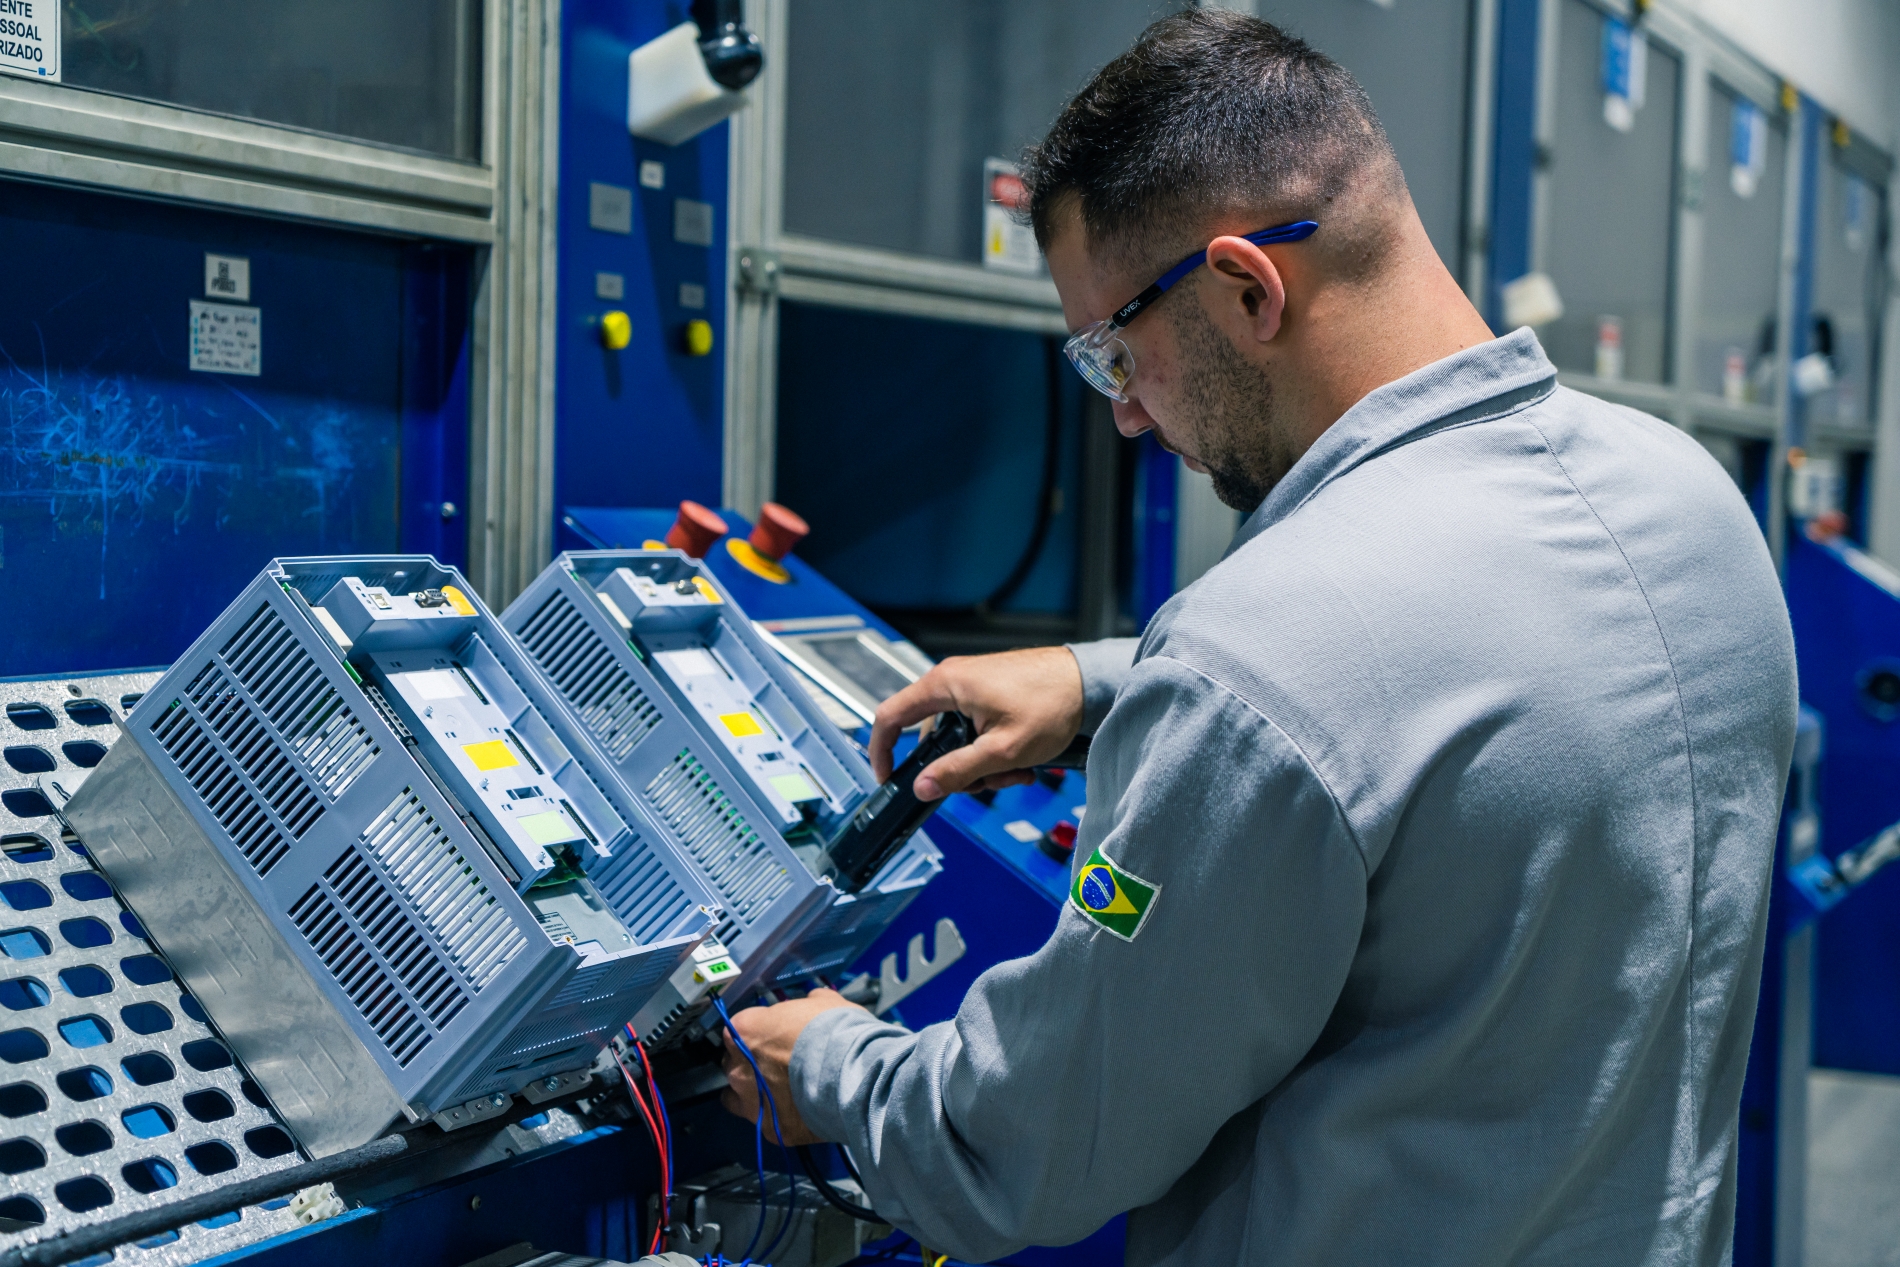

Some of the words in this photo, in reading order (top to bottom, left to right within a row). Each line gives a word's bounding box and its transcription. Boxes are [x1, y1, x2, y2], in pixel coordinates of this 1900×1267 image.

[0, 0, 33, 19] ENTE
[0, 18, 42, 42] SSOAL
[1119, 299, 1141, 317] UVEX
